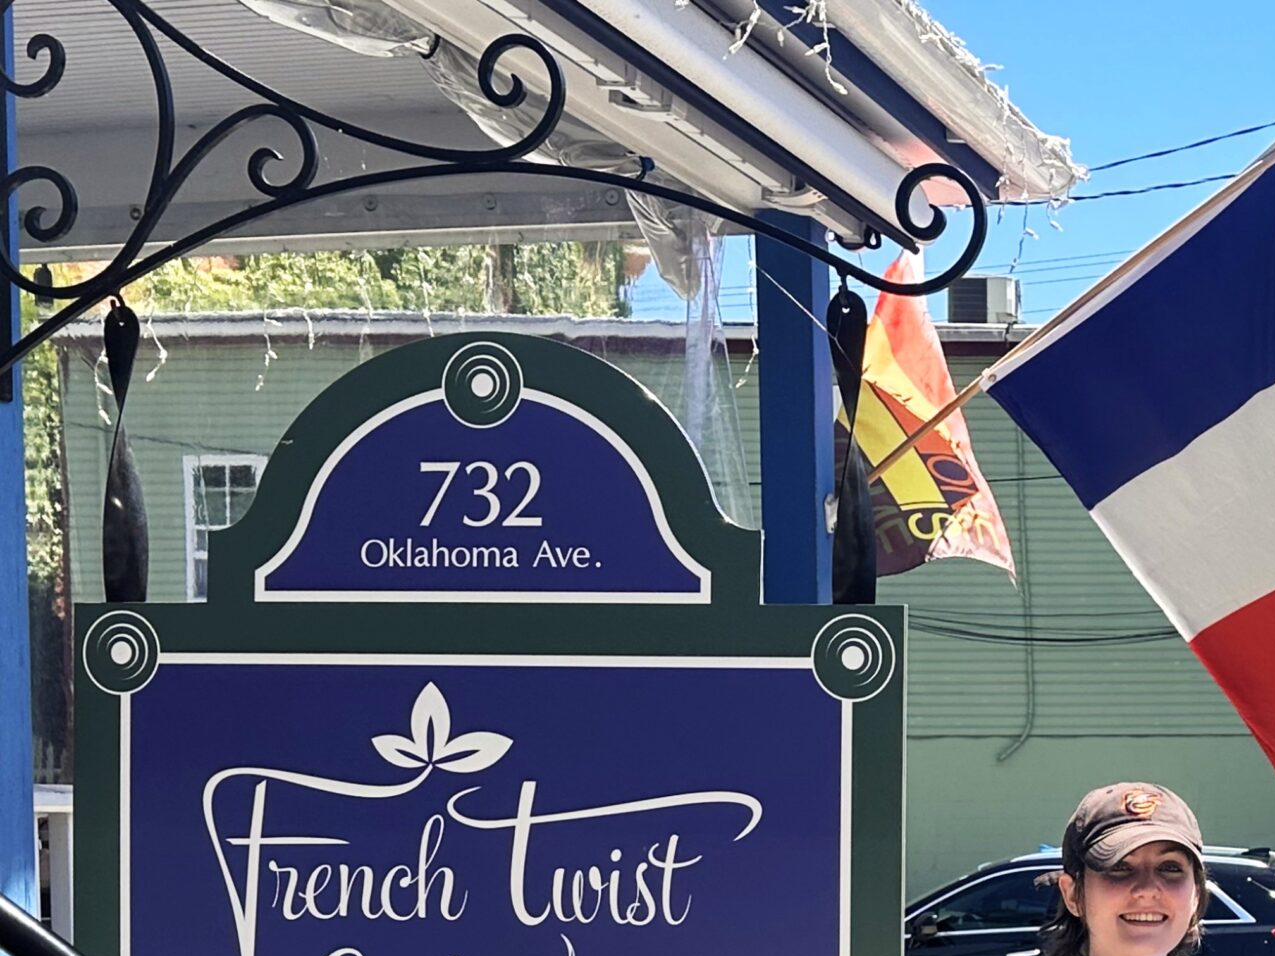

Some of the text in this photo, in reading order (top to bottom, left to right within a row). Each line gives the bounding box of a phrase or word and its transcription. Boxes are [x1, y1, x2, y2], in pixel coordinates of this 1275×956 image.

[420, 461, 543, 527] 732
[360, 538, 602, 569] Oklahoma Ave.
[447, 781, 763, 927] Twist
